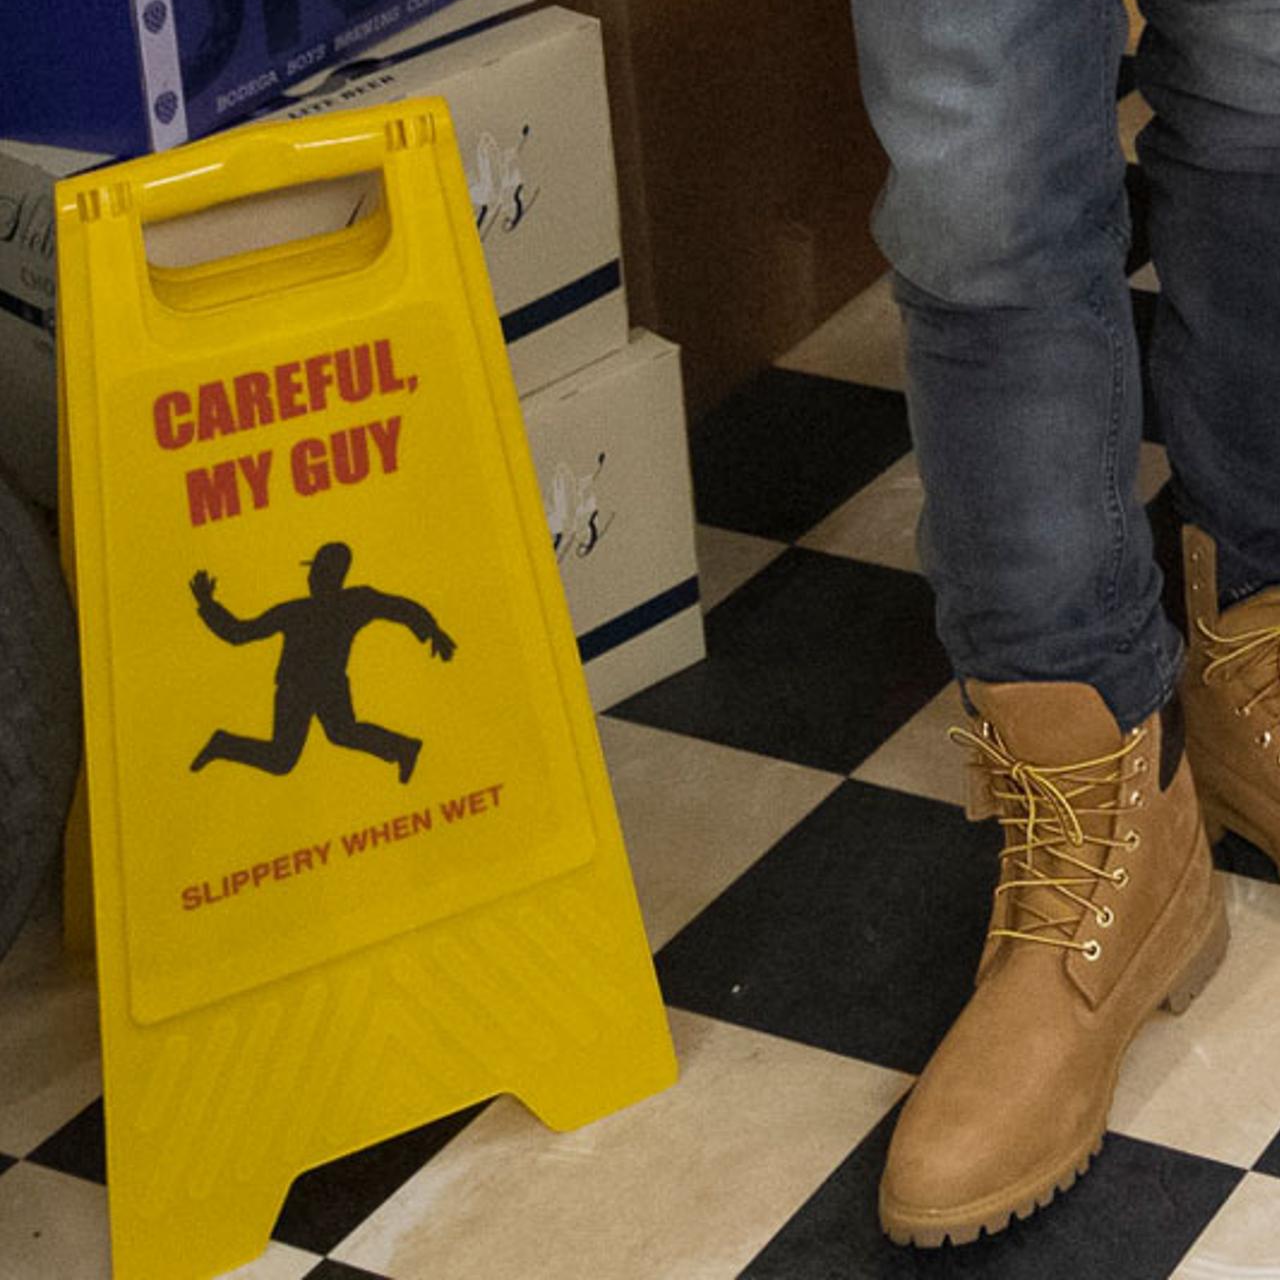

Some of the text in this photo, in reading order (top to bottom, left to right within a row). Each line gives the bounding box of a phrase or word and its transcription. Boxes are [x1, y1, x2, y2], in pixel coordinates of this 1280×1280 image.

[216, 69, 279, 113] BODEGA
[287, 43, 328, 77] BOYS
[334, 8, 401, 51] BREWING
[342, 73, 396, 101] BEER
[153, 339, 420, 451] CAREFUL,
[186, 416, 403, 528] MY GUY
[180, 784, 504, 912] SLIPPERY WHEN WET
